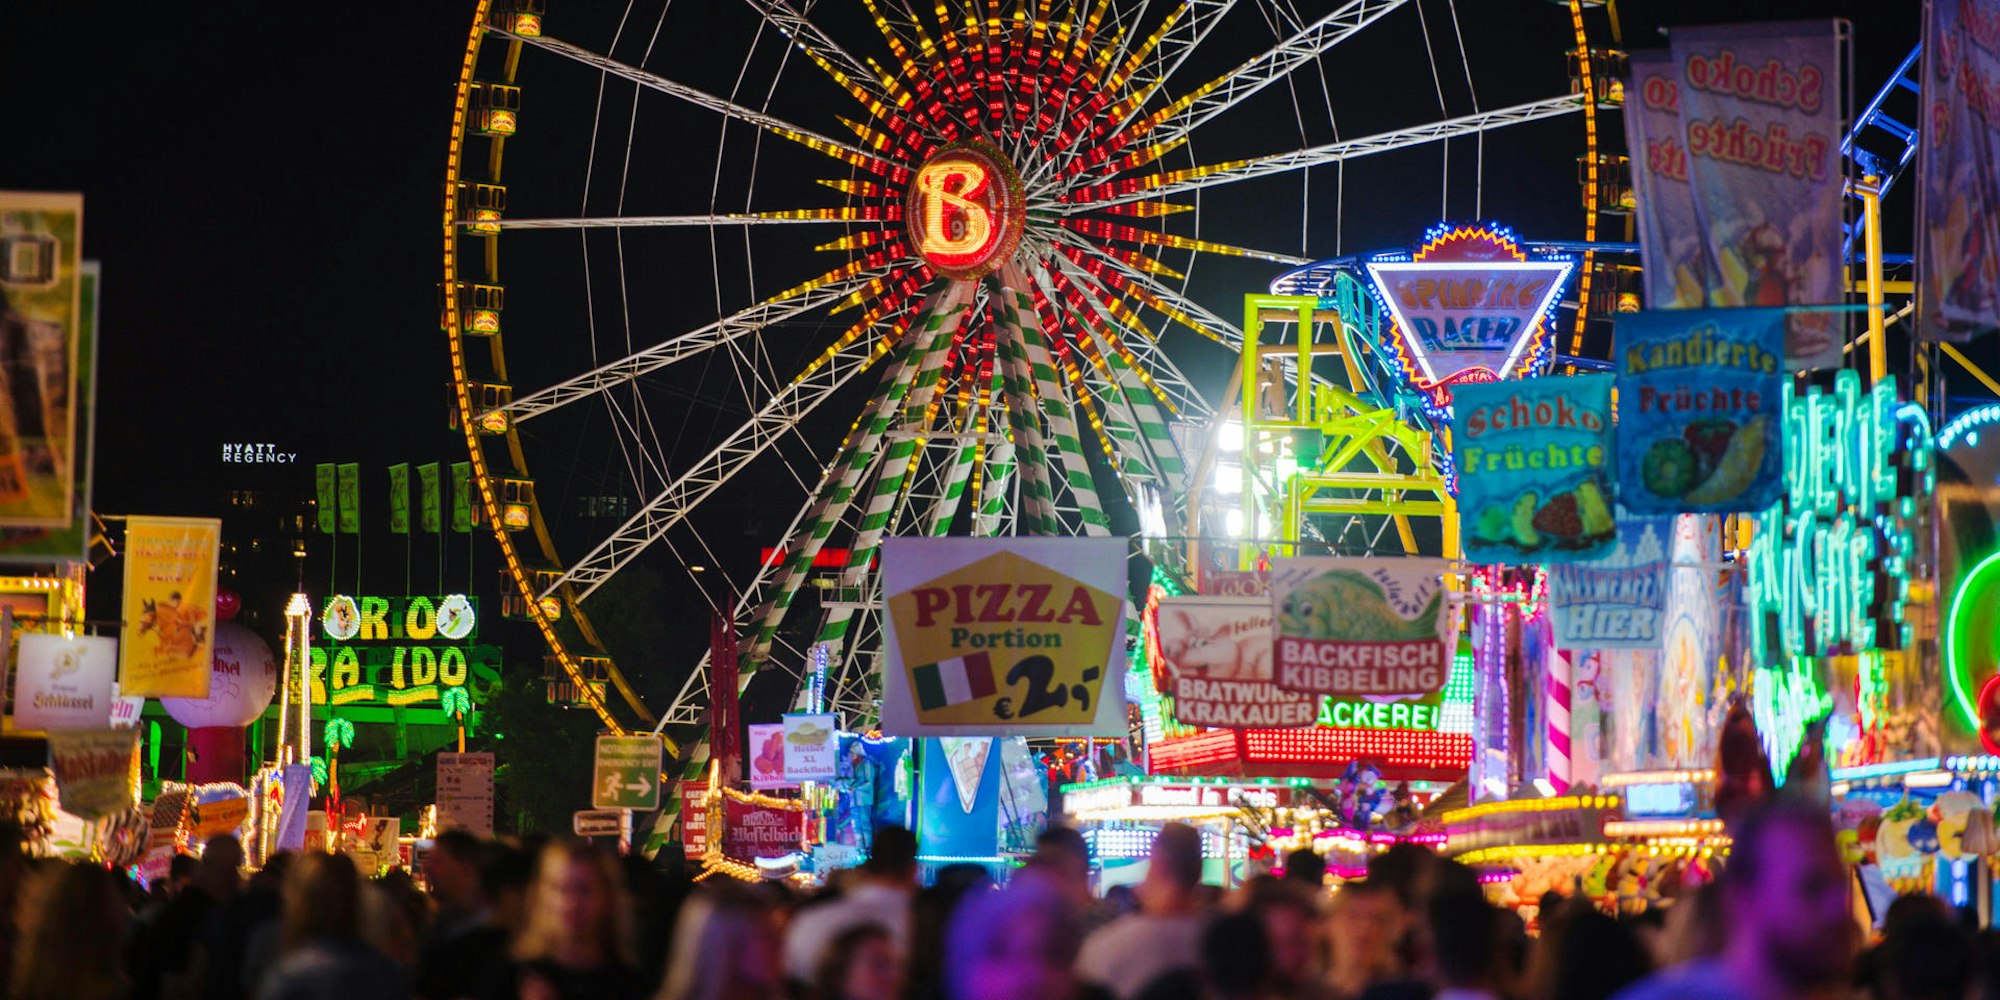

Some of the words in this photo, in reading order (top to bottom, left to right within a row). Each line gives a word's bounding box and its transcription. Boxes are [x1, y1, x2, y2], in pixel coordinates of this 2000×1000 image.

[1395, 278, 1546, 310] SPINNING
[1410, 317, 1522, 350] RACER
[1627, 324, 1778, 375] Kandierte
[1639, 386, 1761, 413] Früchte
[223, 443, 275, 453] HYATT
[223, 453, 296, 463] REGENCY
[1462, 443, 1604, 474] Früchte
[911, 583, 1103, 627] PIZZA
[1565, 605, 1655, 640] HIER
[951, 627, 1062, 648] Portion
[1281, 640, 1440, 667] BACKFISCH
[1281, 664, 1439, 692] KIBBELING
[1178, 700, 1313, 725] KRAKAUER
